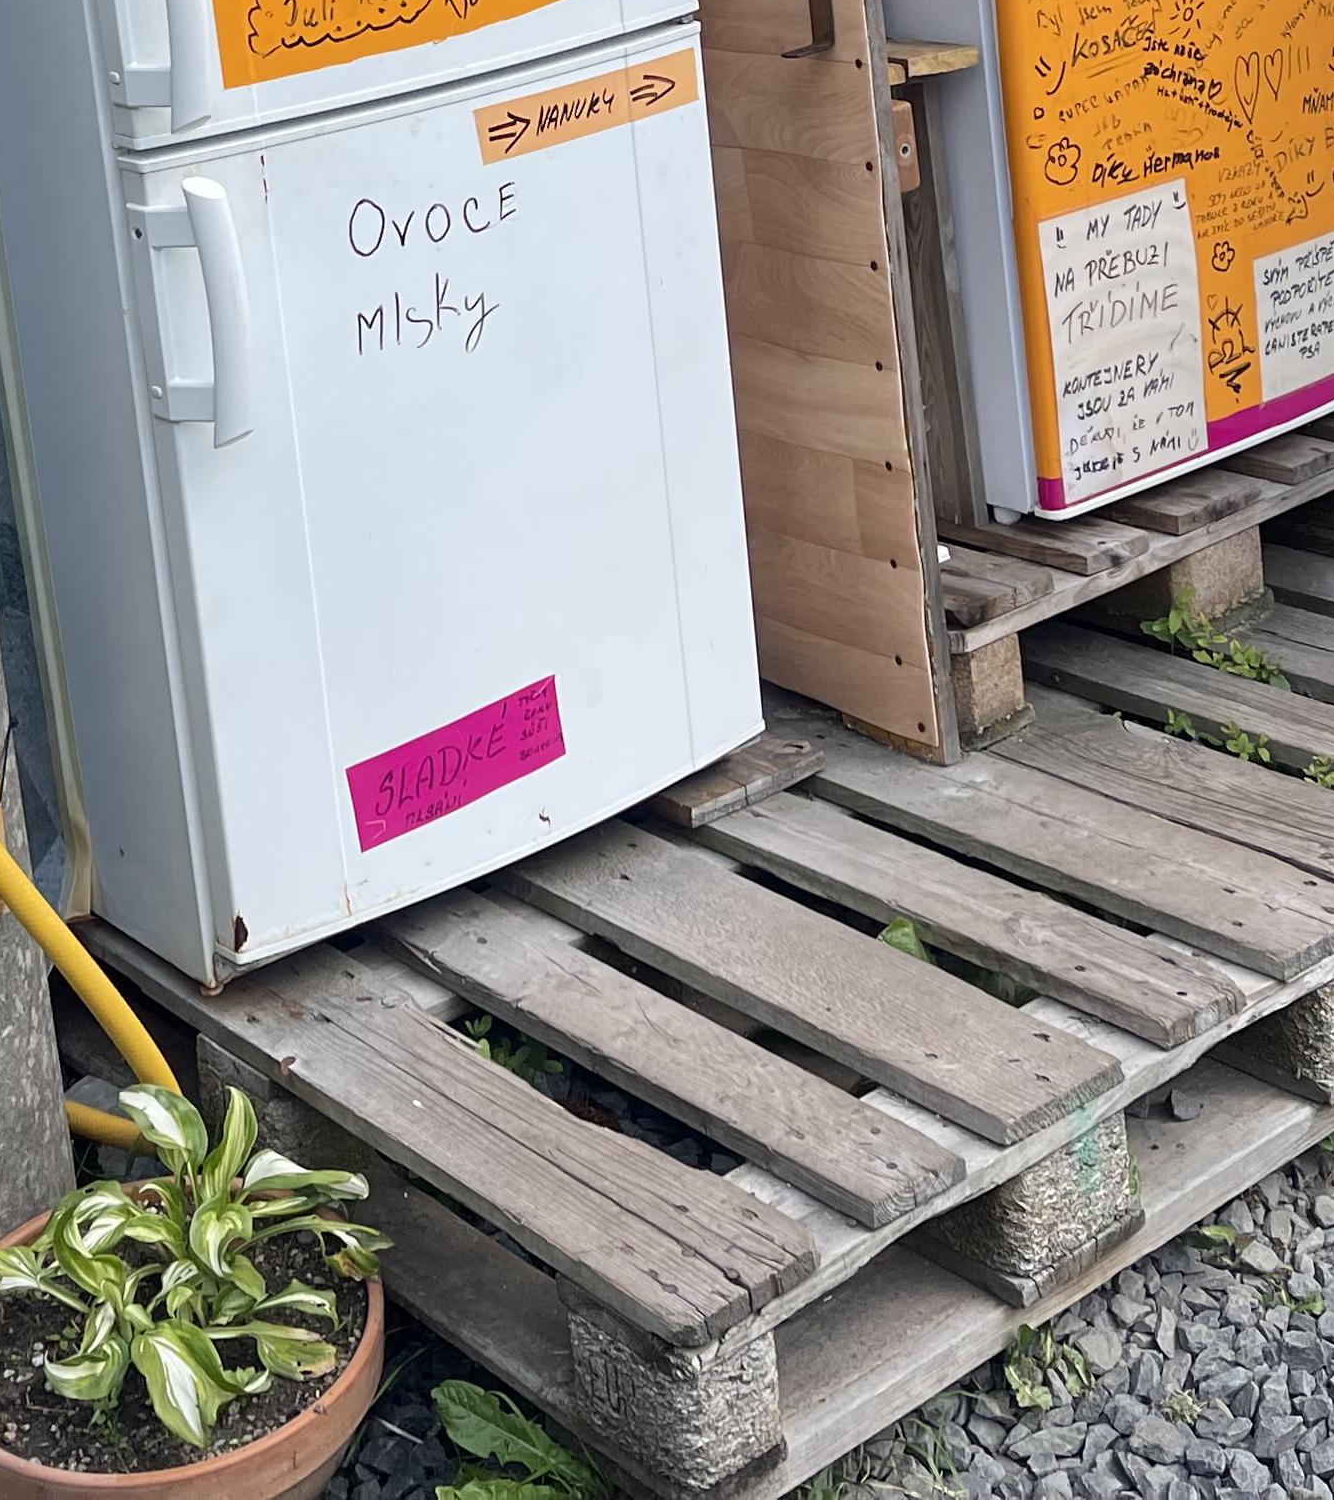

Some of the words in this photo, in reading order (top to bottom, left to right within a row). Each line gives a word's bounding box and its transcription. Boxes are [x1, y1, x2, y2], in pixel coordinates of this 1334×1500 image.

[1086, 214, 1110, 241] MY
[1123, 199, 1163, 232] TADY
[1054, 267, 1076, 298] NA
[1298, 341, 1321, 361] PSA
[1062, 352, 1160, 399] KONTEJNERY
[1077, 394, 1112, 421] JSOU
[1117, 386, 1136, 408] ZA
